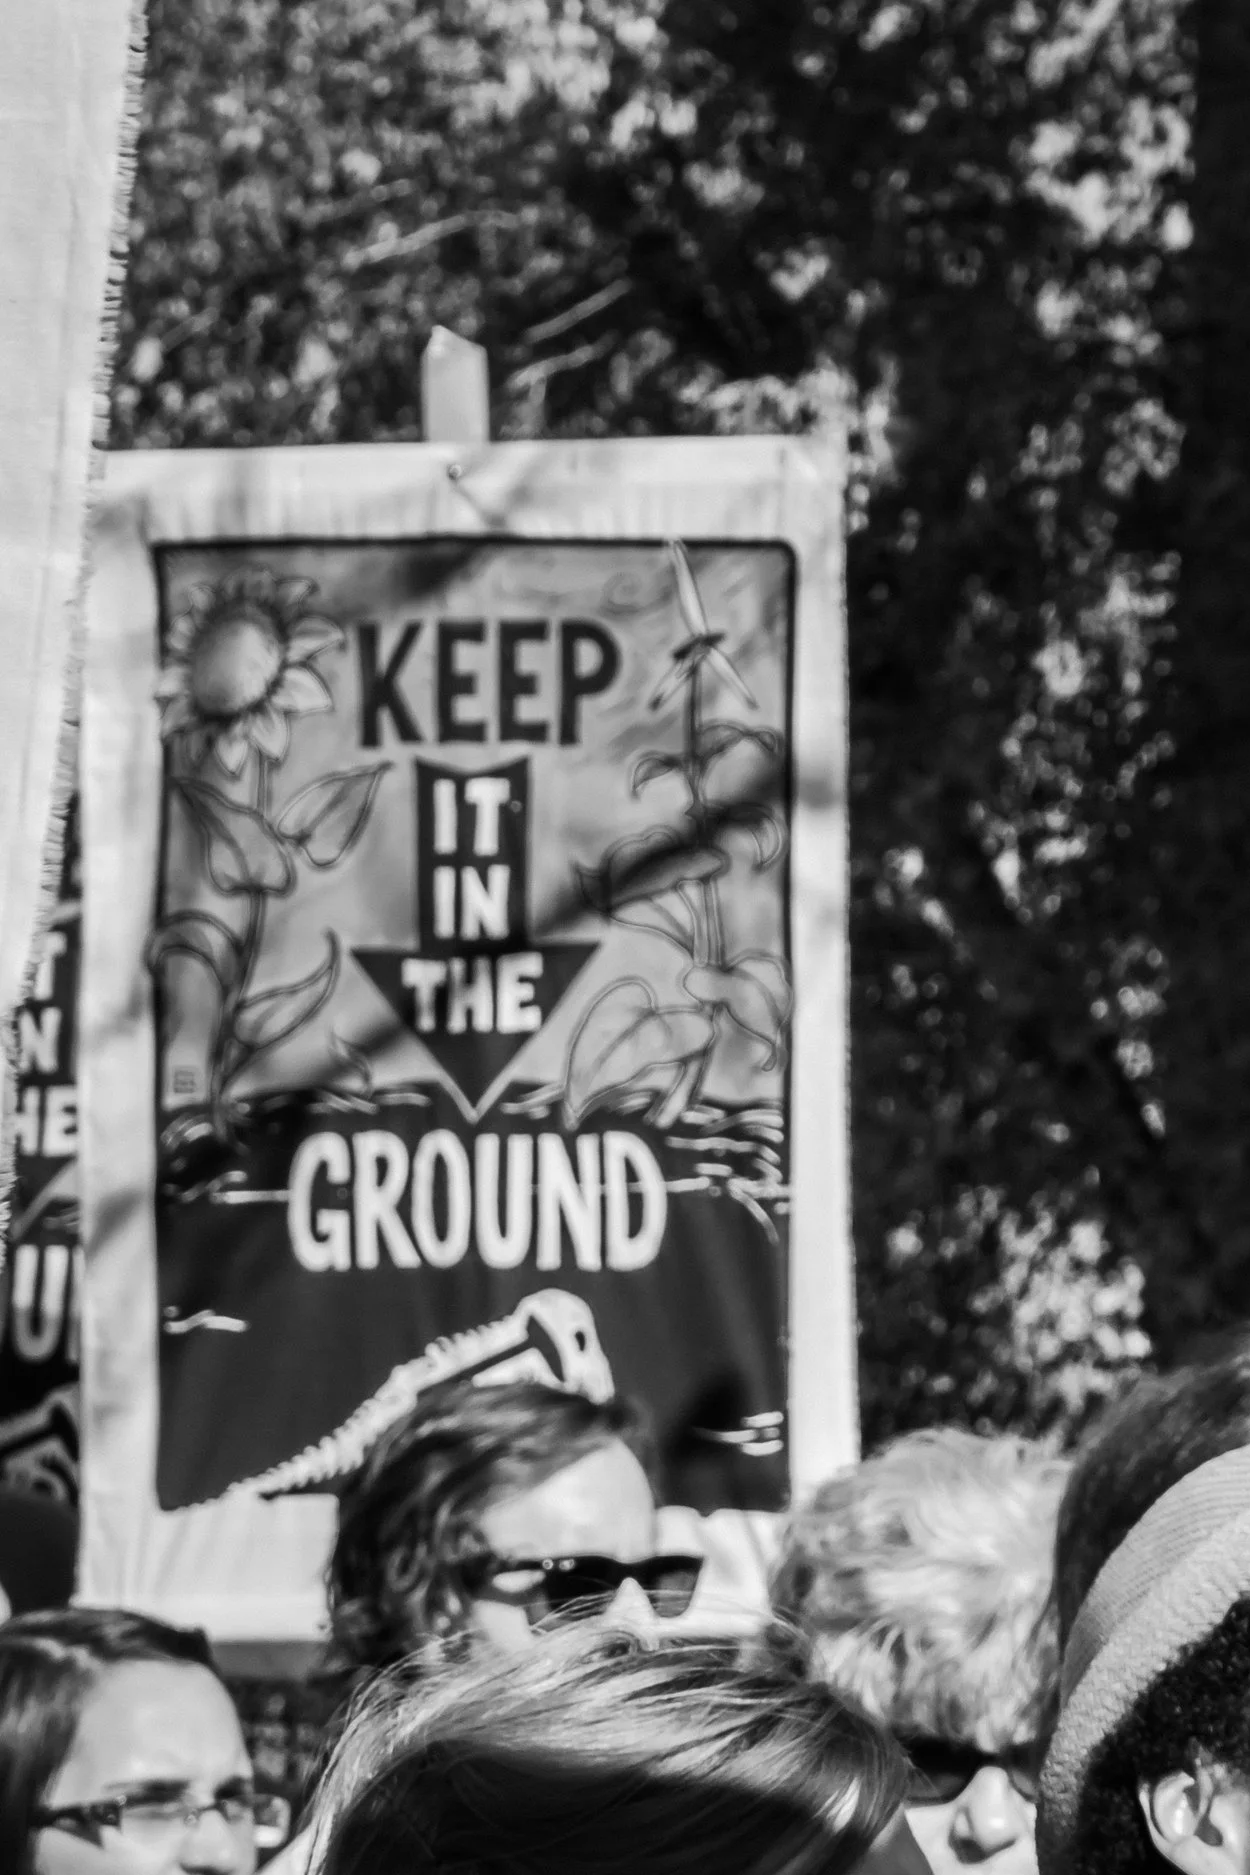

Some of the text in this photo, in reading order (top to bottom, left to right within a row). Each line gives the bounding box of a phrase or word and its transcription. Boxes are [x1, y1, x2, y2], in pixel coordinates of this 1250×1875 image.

[357, 617, 623, 748] KEEP
[431, 776, 511, 857] IT
[431, 862, 511, 941] IN
[400, 950, 544, 1035] THE
[286, 1128, 668, 1273] GROUND
